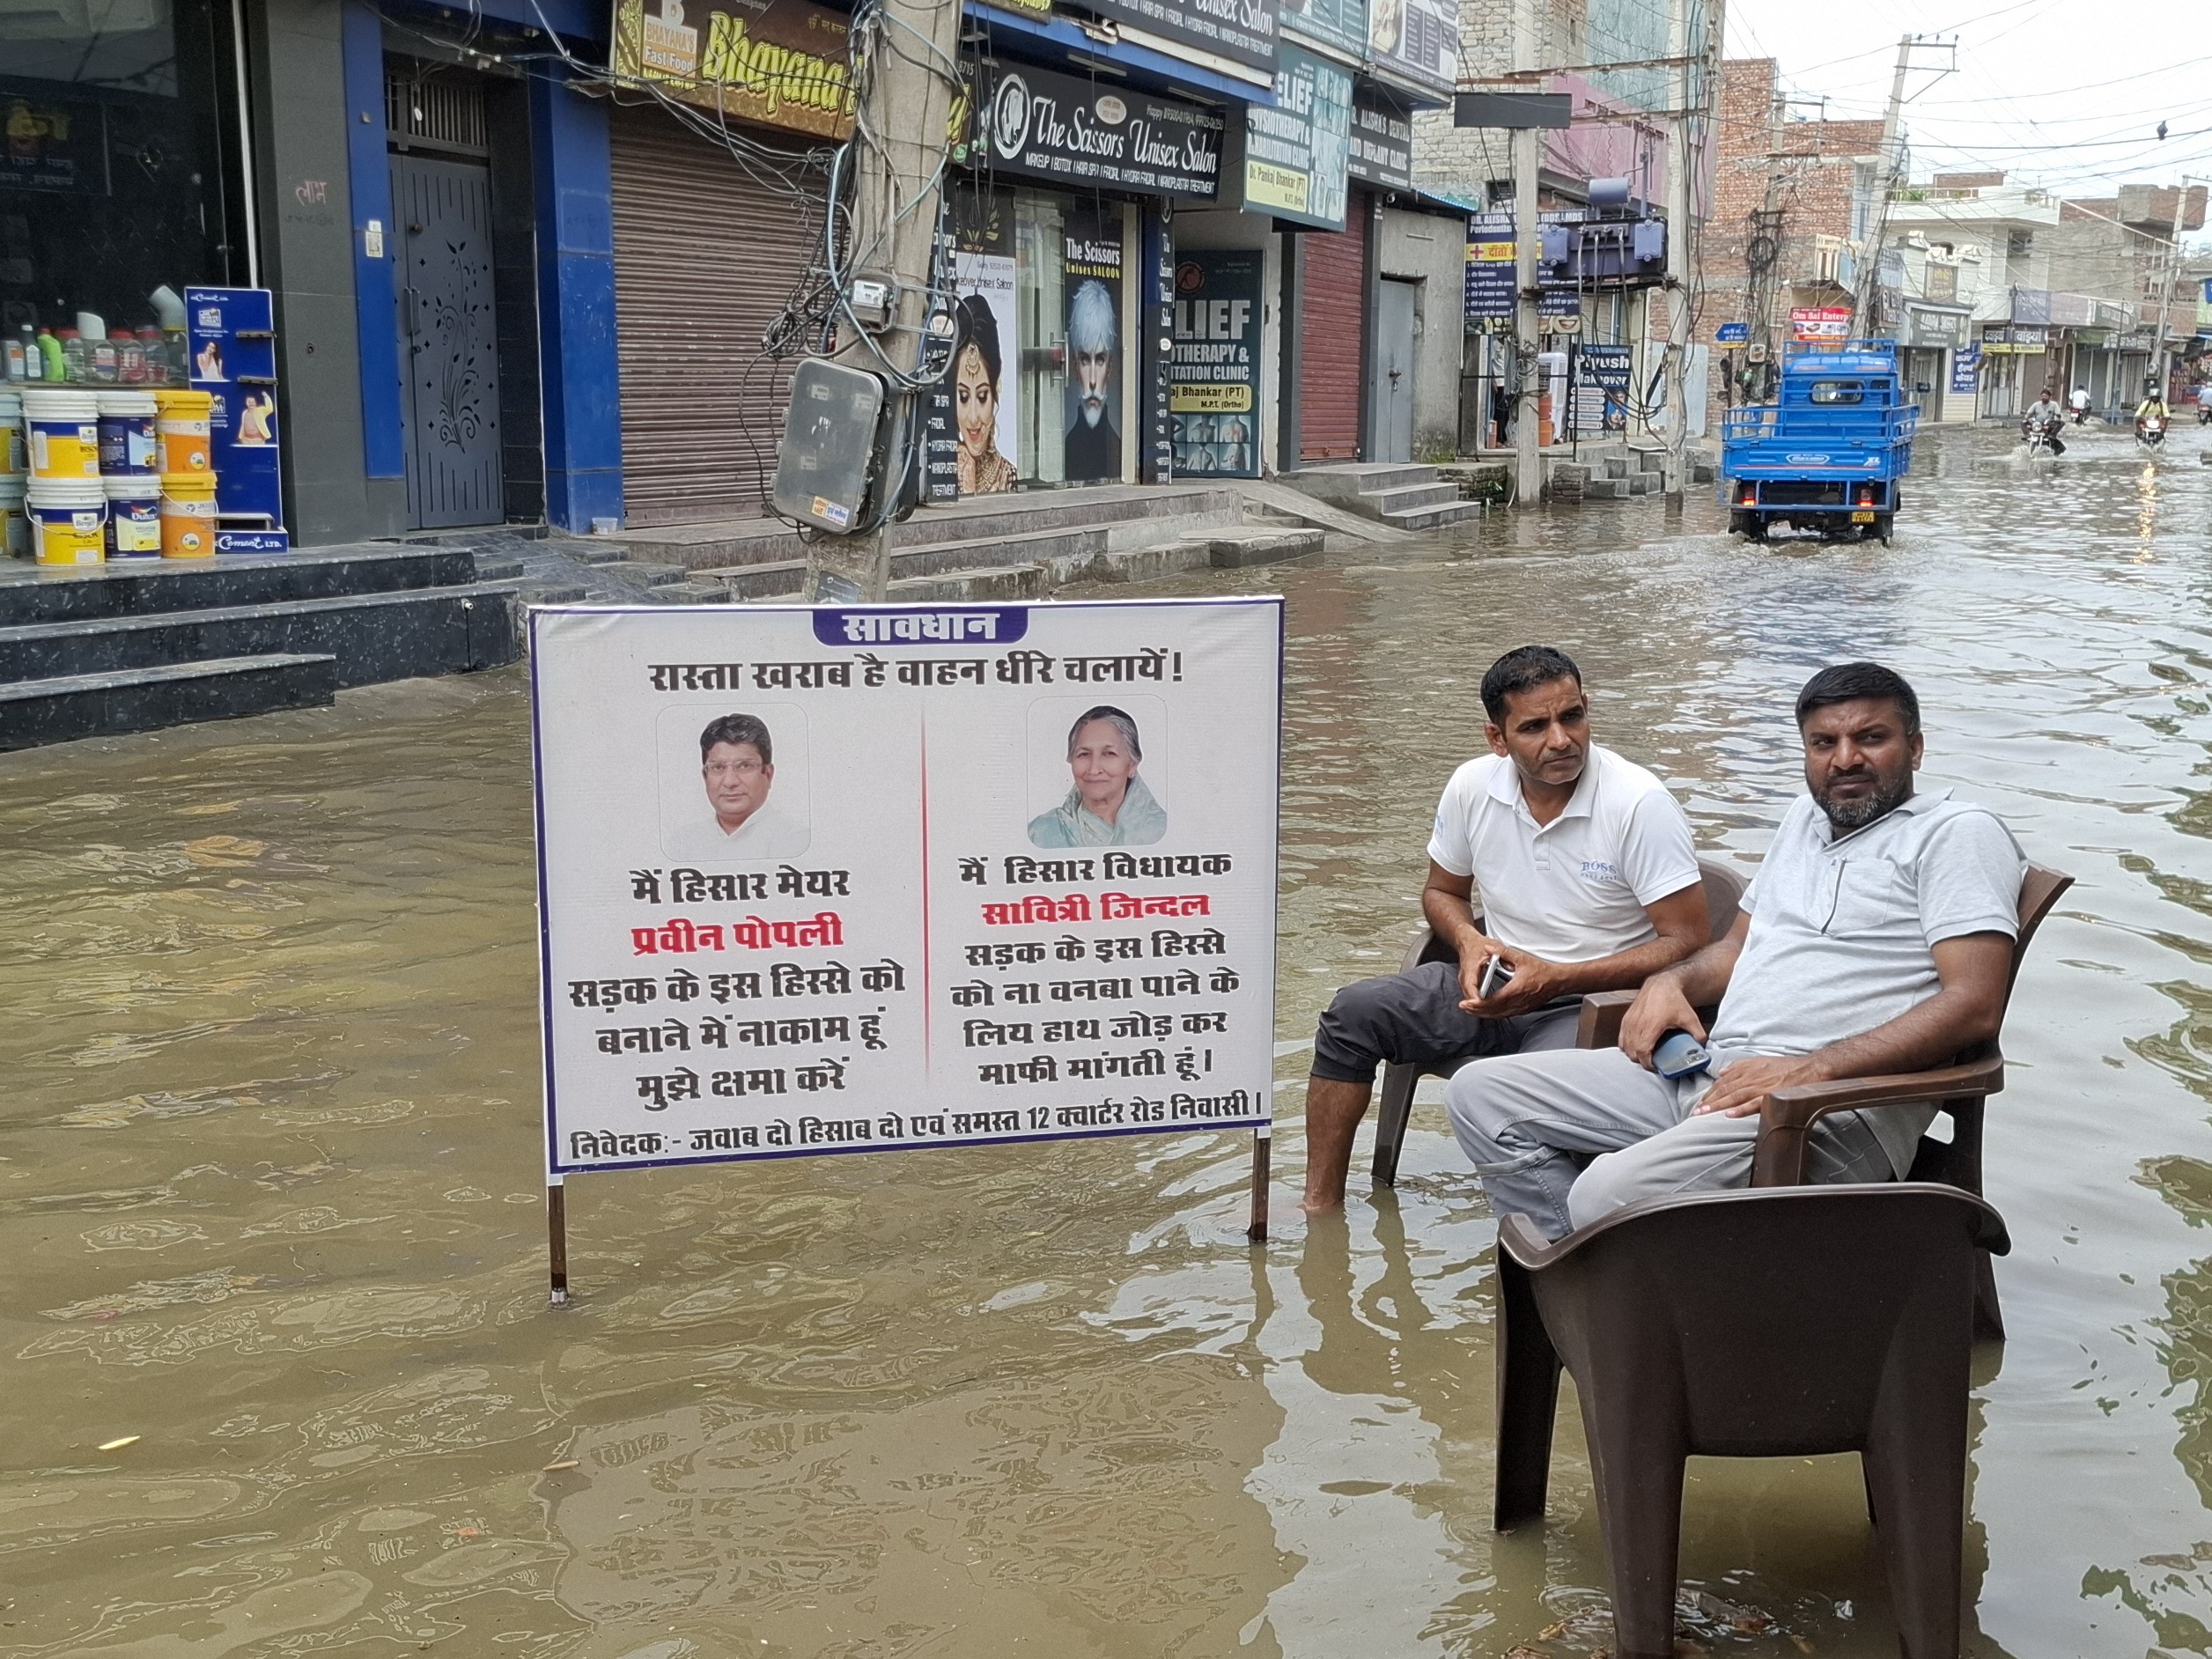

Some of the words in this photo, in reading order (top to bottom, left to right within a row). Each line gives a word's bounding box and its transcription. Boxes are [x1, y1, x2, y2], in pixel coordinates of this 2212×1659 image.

[644, 47, 668, 66] Fast
[669, 53, 694, 72] Food
[1277, 70, 1314, 115] ELIEF
[1033, 96, 1065, 148] The
[1066, 107, 1124, 159] Scissors
[1130, 119, 1180, 169] Unisex
[1181, 130, 1217, 175] Salon
[1065, 237, 1083, 261] The
[1084, 241, 1120, 266] Scissors
[1065, 262, 1092, 276] Unisex
[1092, 265, 1121, 279] SALOON
[1175, 299, 1251, 340] LIEF
[1171, 344, 1236, 363] THERAPY
[1238, 347, 1250, 363] &
[1213, 365, 1250, 380] CLINIC
[1182, 387, 1222, 397] Bhankar
[1225, 386, 1245, 400] (PT)
[1574, 372, 1627, 386] Makover
[218, 535, 264, 550] Cement
[842, 612, 1001, 642] सावधान
[647, 662, 744, 692] रास्ता
[750, 660, 854, 690] खराब
[852, 653, 889, 688] है
[896, 658, 988, 687] वाहन
[996, 649, 1056, 685] धीरे
[629, 868, 663, 904] मैं
[669, 867, 770, 903] हिसार
[775, 864, 852, 898] मेयर
[957, 856, 989, 886] मैं
[1004, 855, 1096, 884] हिसार
[1102, 852, 1233, 881] विधायक
[1582, 860, 1618, 874] BOSS
[981, 894, 1091, 925] सावित्री
[1099, 891, 1212, 920] जिन्दल
[630, 918, 726, 957] प्रवीन
[732, 911, 845, 950] पोपली
[964, 940, 1047, 971] सड़क
[1054, 934, 1086, 962] के
[1094, 937, 1143, 964] इस
[1150, 927, 1227, 958] हिस्से
[567, 977, 658, 1014] सड़क
[664, 968, 701, 1002] के
[708, 970, 763, 1005] इस
[769, 960, 852, 998] हिस्से
[859, 958, 906, 992] को
[950, 978, 995, 1007] को
[1002, 982, 1041, 1005] ना
[1049, 977, 1133, 1002] वनबा
[1140, 968, 1201, 997] पाने
[1208, 966, 1241, 994] के
[595, 1017, 693, 1056] बनाने
[698, 1014, 734, 1049] में
[736, 1015, 852, 1048] नाकाम
[858, 1006, 888, 1051] हूं
[962, 1018, 1035, 1048] लिय
[1041, 1017, 1102, 1043] हाथ
[1109, 1010, 1174, 1042] जोड़
[1180, 1011, 1228, 1035] कर
[636, 1066, 703, 1112] मुझे
[711, 1067, 788, 1098] क्षमा
[795, 1056, 852, 1092] करें
[977, 1054, 1058, 1086] माफी
[1065, 1048, 1167, 1080] मांगती
[688, 1124, 761, 1153] जवाब
[765, 1118, 793, 1146] दो
[798, 1116, 874, 1145] हिसाब
[877, 1111, 905, 1139] दो
[910, 1107, 949, 1138] एवं
[952, 1108, 1021, 1136] समस्त
[1026, 1106, 1051, 1131] 12
[1056, 1097, 1125, 1128] क्वार्टर
[1129, 1095, 1166, 1123] रोड
